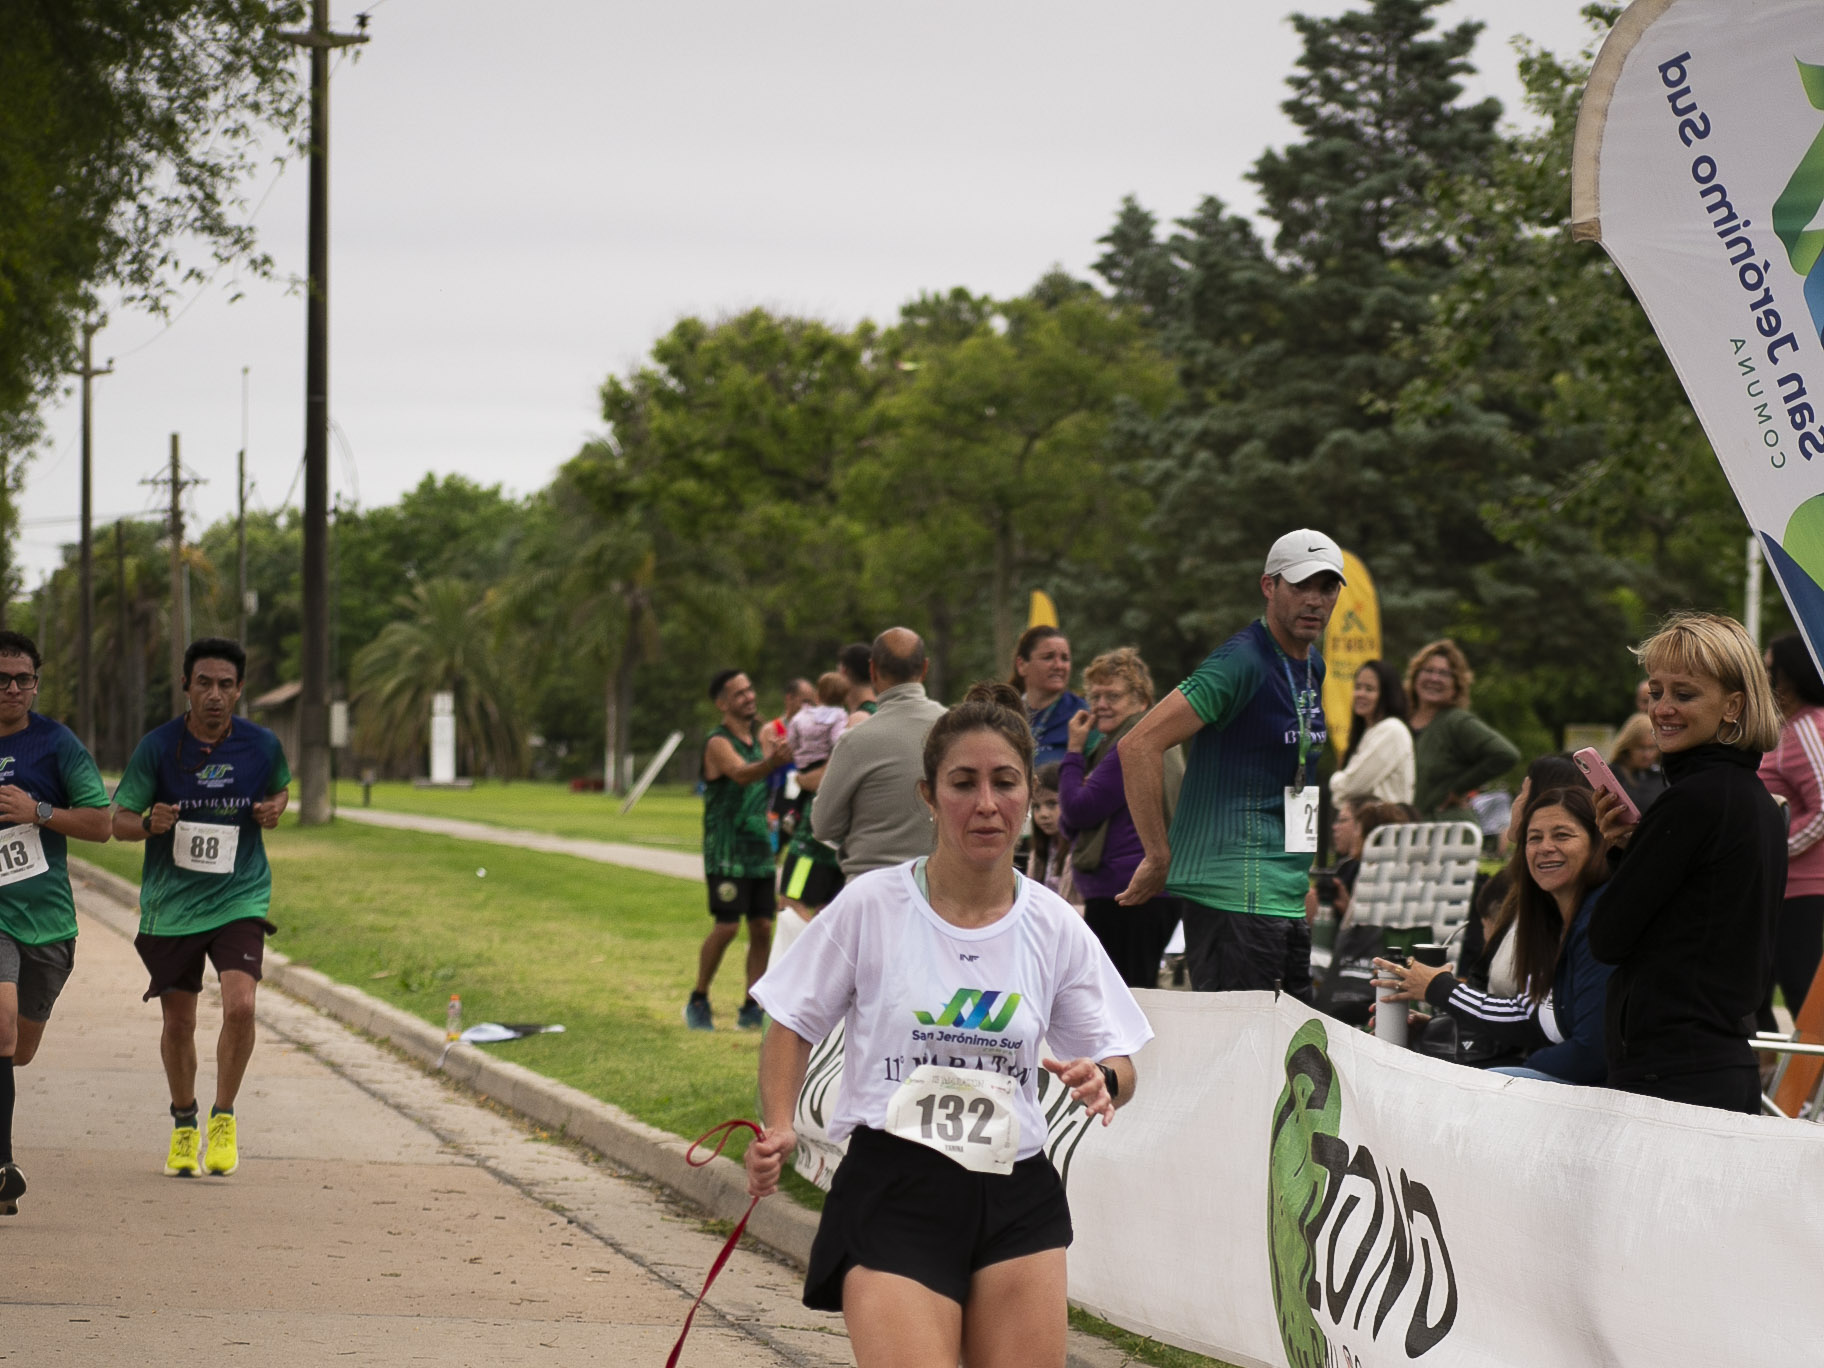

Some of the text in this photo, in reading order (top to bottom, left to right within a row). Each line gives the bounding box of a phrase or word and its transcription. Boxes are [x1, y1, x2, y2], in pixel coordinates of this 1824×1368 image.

[0, 840, 29, 872] 13
[190, 835, 220, 860] 88
[912, 1029, 1024, 1050] San Jerónimo Sud
[915, 1093, 995, 1145] 132
